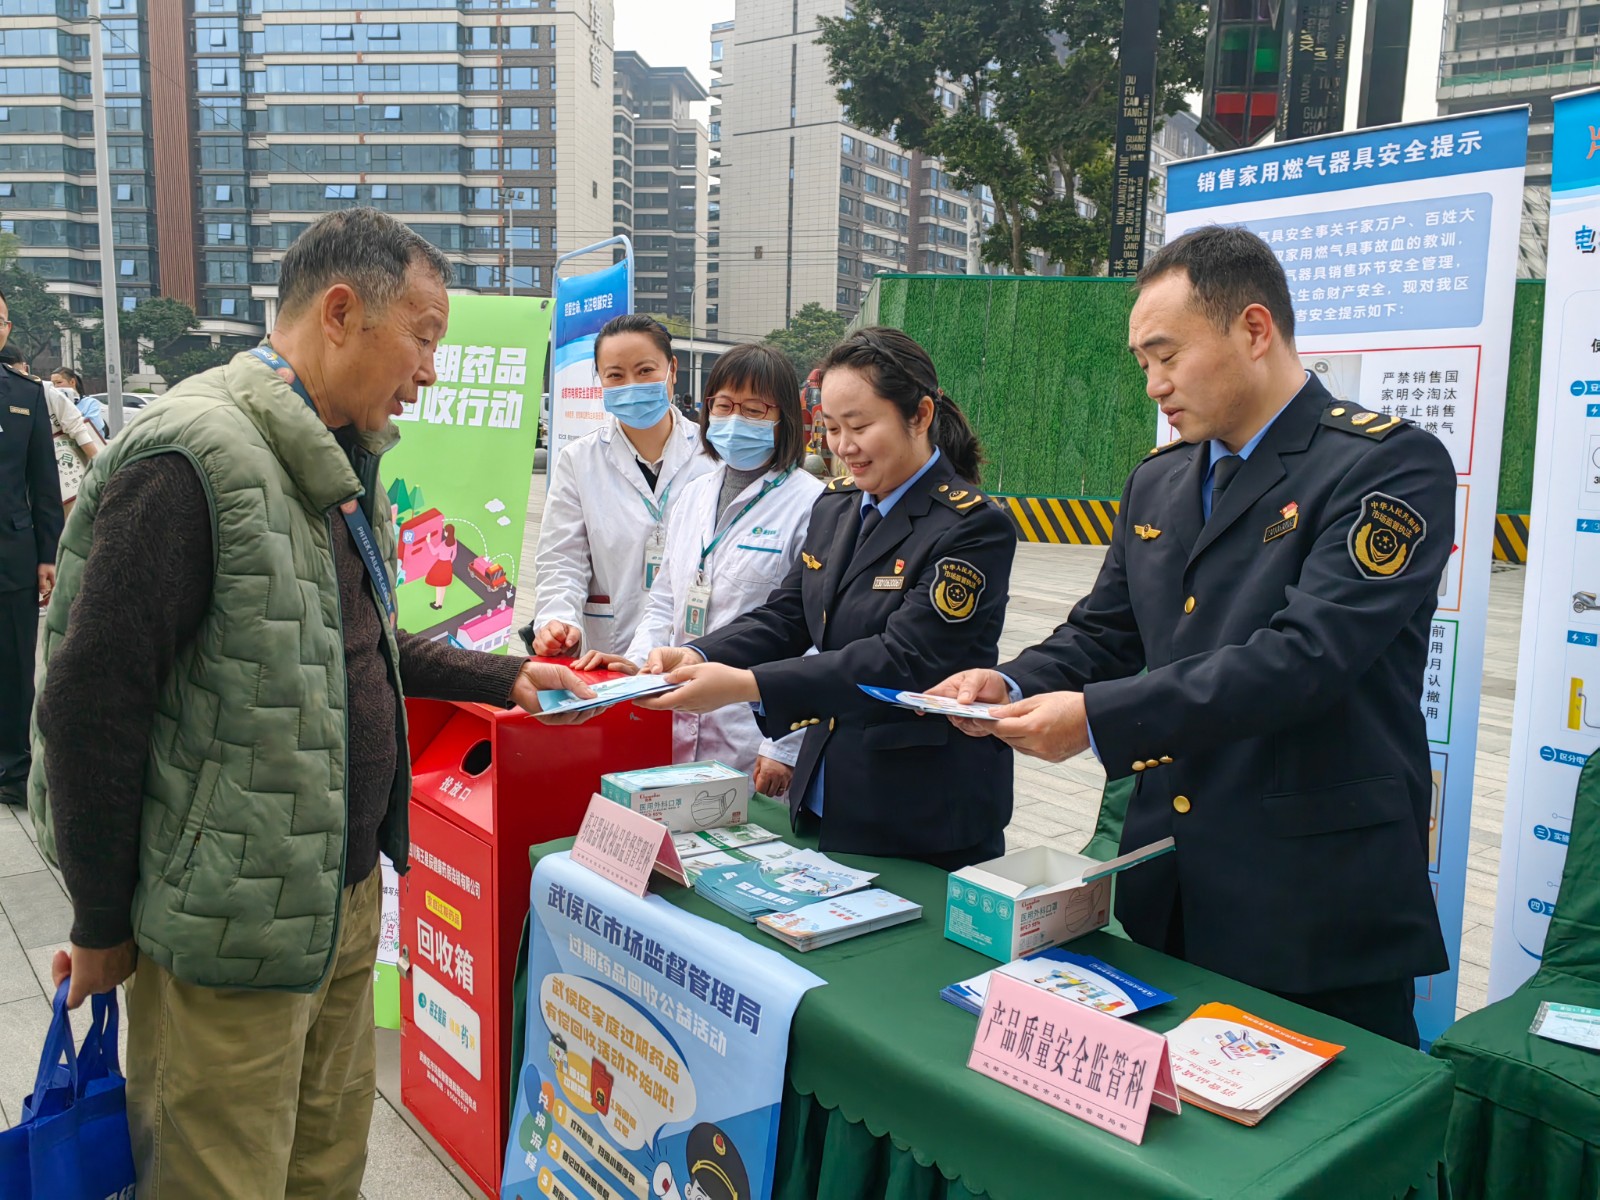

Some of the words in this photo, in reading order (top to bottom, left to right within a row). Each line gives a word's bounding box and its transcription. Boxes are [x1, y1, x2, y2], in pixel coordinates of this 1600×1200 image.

[1124, 86, 1135, 95] FU
[1123, 108, 1142, 118] TANG
[1197, 130, 1483, 193] 销售家用燃气器具安全提示
[1382, 370, 1459, 384] 严禁销售国
[1381, 387, 1457, 401] 家明令淘汰
[1371, 501, 1421, 534] 中华人民共和国
[1560, 752, 1587, 767] 区分电
[439, 775, 472, 802] 投放口
[416, 916, 475, 996] 回收箱
[546, 882, 763, 1037] 武侯区市场监督管理局
[568, 933, 728, 1057] 过期药品回收公益活动
[551, 976, 680, 1085] 武侯区家庭过期药品
[545, 999, 676, 1114] 有偿回收活动开始啦！
[982, 1000, 1148, 1110] 产品质量安全监管科
[557, 1105, 564, 1117] 1
[524, 1090, 550, 1173] 兑换流程
[550, 1139, 558, 1153] 2
[541, 1173, 549, 1187] 3
